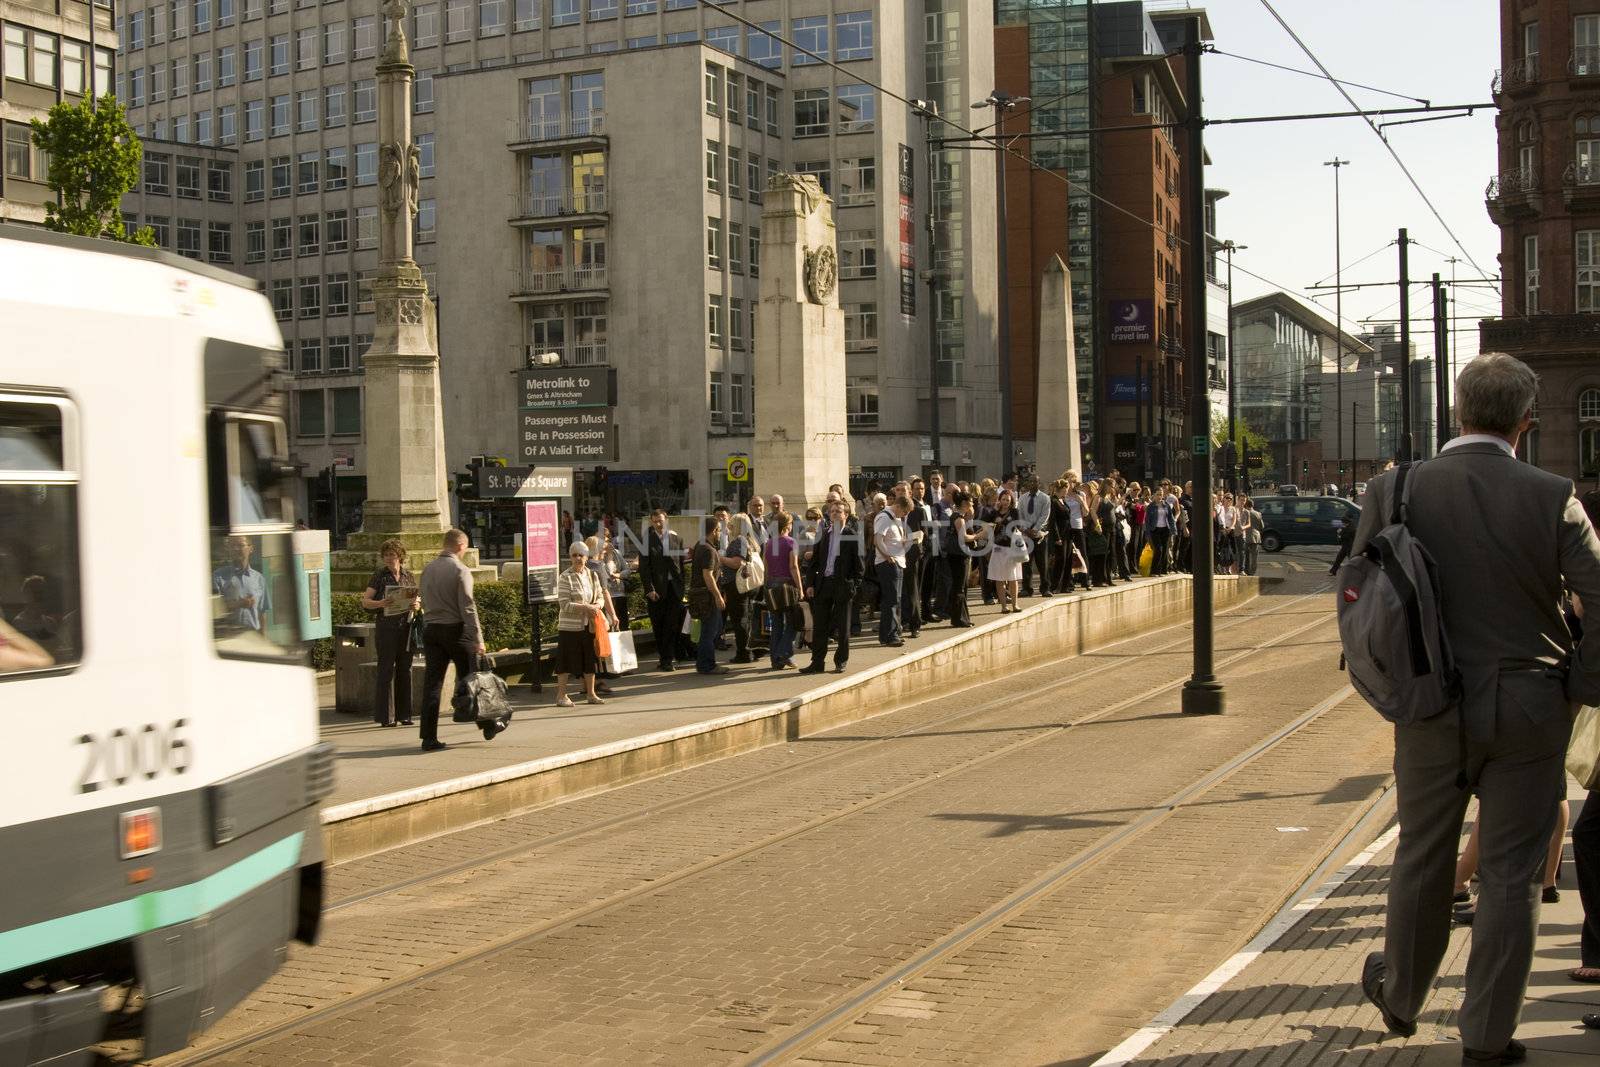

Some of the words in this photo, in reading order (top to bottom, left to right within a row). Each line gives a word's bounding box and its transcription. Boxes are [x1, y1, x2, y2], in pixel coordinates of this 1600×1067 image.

[1114, 323, 1146, 333] premier
[1112, 332, 1134, 340] travel
[1136, 332, 1150, 340] inn
[526, 377, 575, 390] Metrolink
[578, 377, 590, 388] to
[524, 416, 578, 427] Passengers
[581, 414, 607, 424] Must
[525, 431, 538, 440] Be
[540, 431, 550, 440] In
[552, 429, 604, 440] Possession
[524, 446, 536, 456] Of
[539, 446, 547, 455] A
[549, 445, 572, 455] Valid
[574, 444, 604, 454] Ticket
[488, 475, 502, 488] St.
[505, 475, 536, 488] Peters
[537, 475, 568, 490] Square
[70, 718, 192, 794] 2006
